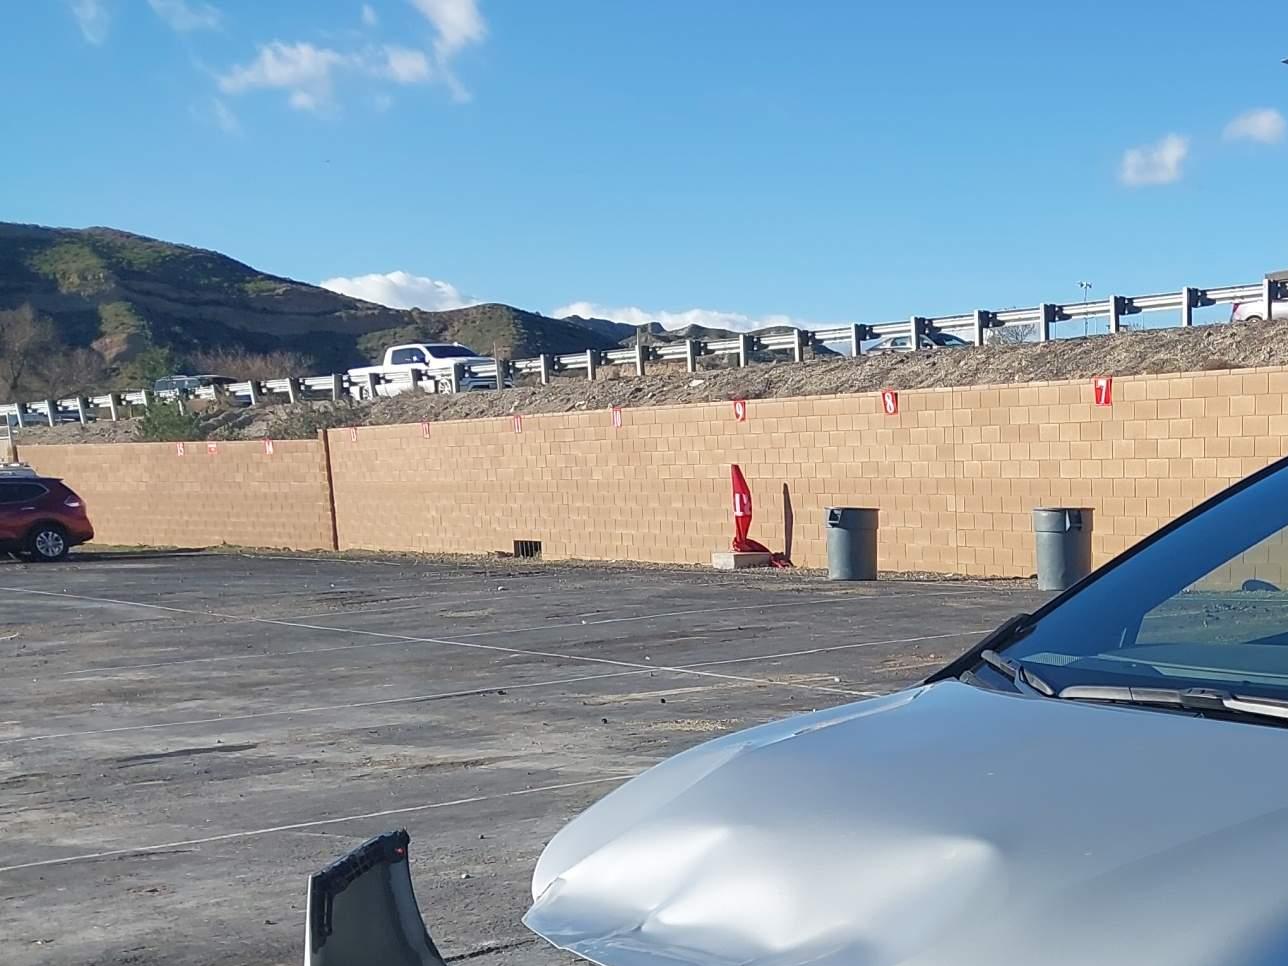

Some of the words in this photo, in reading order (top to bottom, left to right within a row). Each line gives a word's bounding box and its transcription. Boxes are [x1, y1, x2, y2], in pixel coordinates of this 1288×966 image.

[1095, 379, 1108, 404] 7
[735, 401, 744, 421] 9
[884, 392, 895, 414] 8
